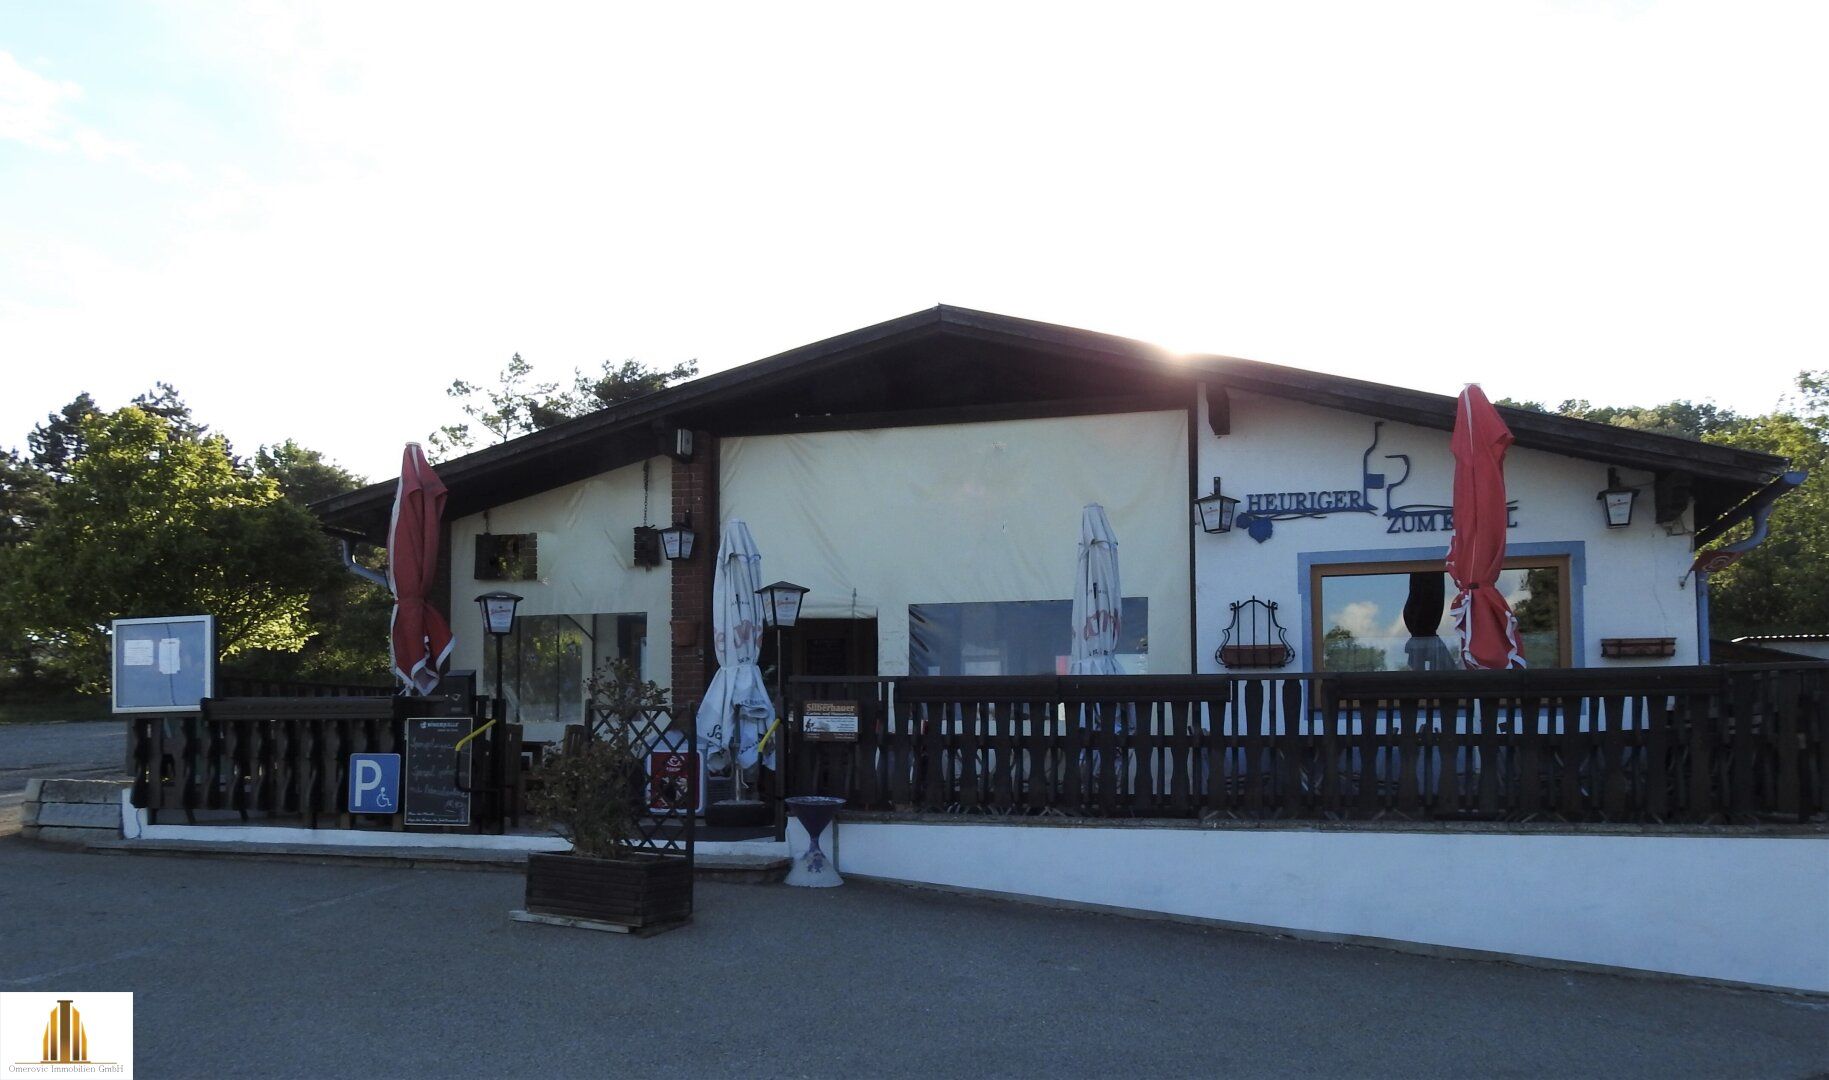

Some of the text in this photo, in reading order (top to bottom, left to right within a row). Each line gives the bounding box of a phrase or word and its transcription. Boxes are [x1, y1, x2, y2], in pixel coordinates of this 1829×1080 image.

[1246, 490, 1363, 513] HEURIGER
[1387, 512, 1437, 534] ZUM
[354, 759, 382, 807] P
